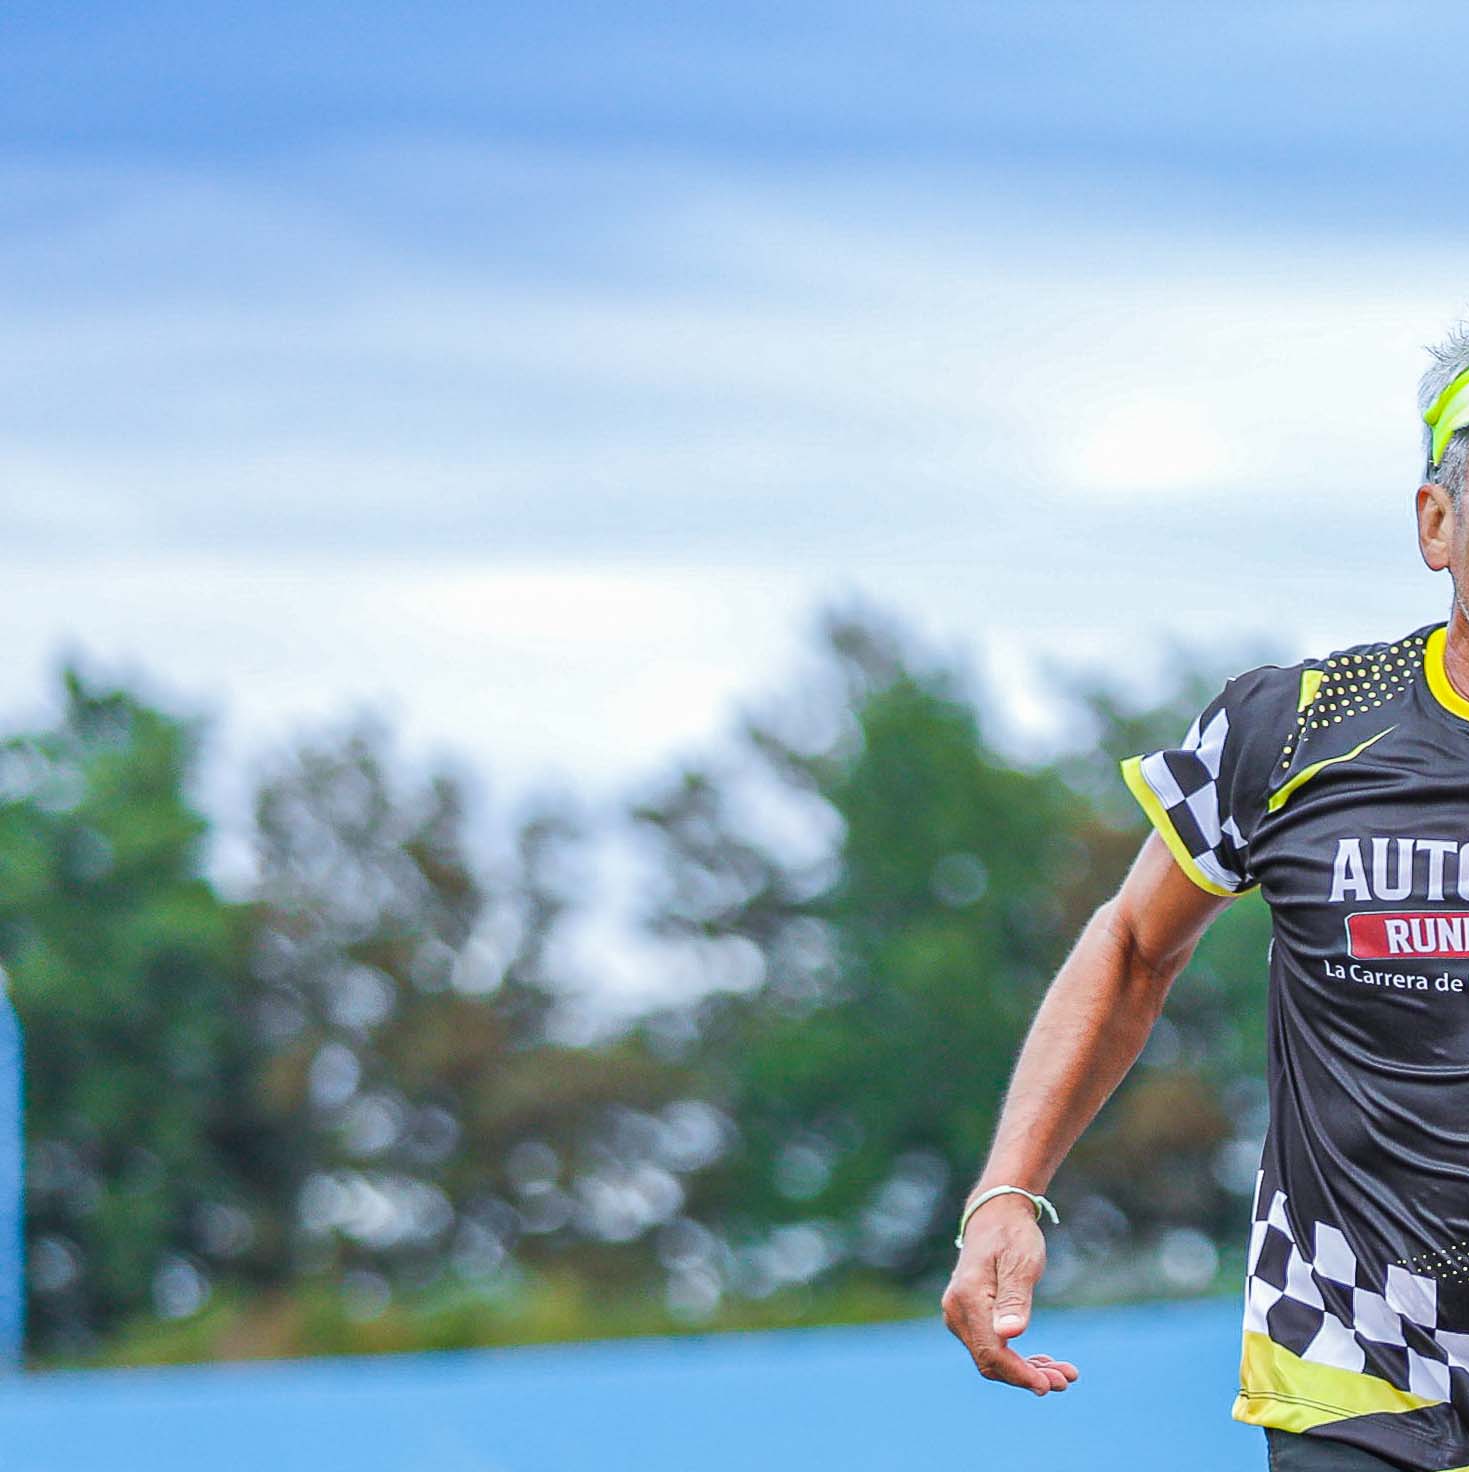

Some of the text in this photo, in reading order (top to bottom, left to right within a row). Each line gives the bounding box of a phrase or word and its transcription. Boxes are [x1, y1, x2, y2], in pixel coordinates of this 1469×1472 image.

[1324, 959, 1346, 979] La
[1350, 964, 1428, 990] Carrera
[1435, 972, 1464, 992] de
